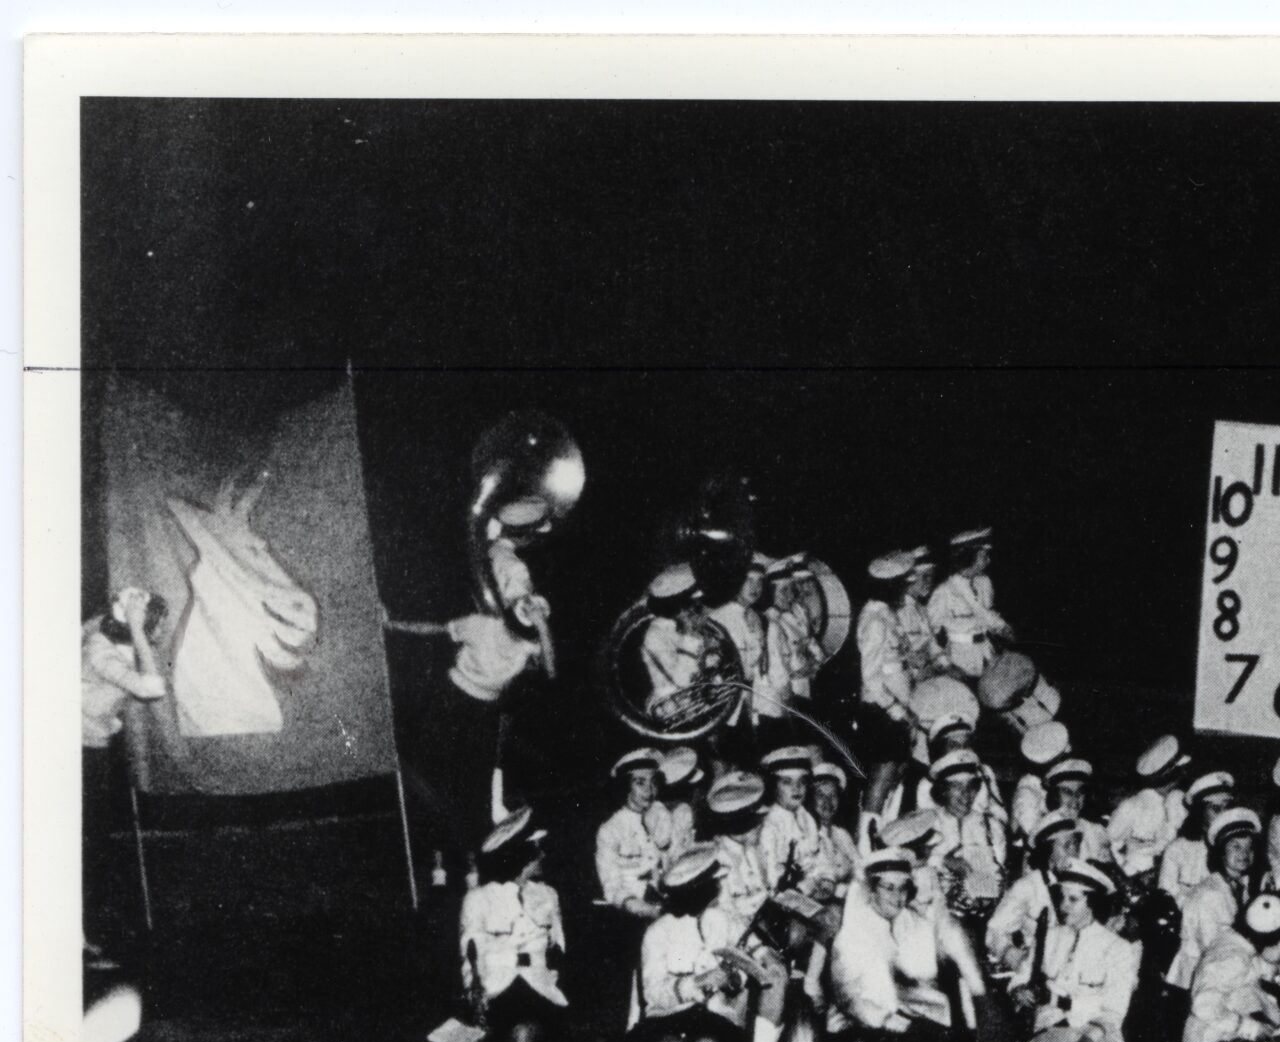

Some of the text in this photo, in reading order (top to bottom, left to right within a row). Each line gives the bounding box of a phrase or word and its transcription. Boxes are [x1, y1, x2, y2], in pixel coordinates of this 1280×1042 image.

[1212, 475, 1253, 527] 10
[1209, 536, 1239, 584] 9
[1213, 589, 1241, 642] 8
[1224, 654, 1260, 704] 7
